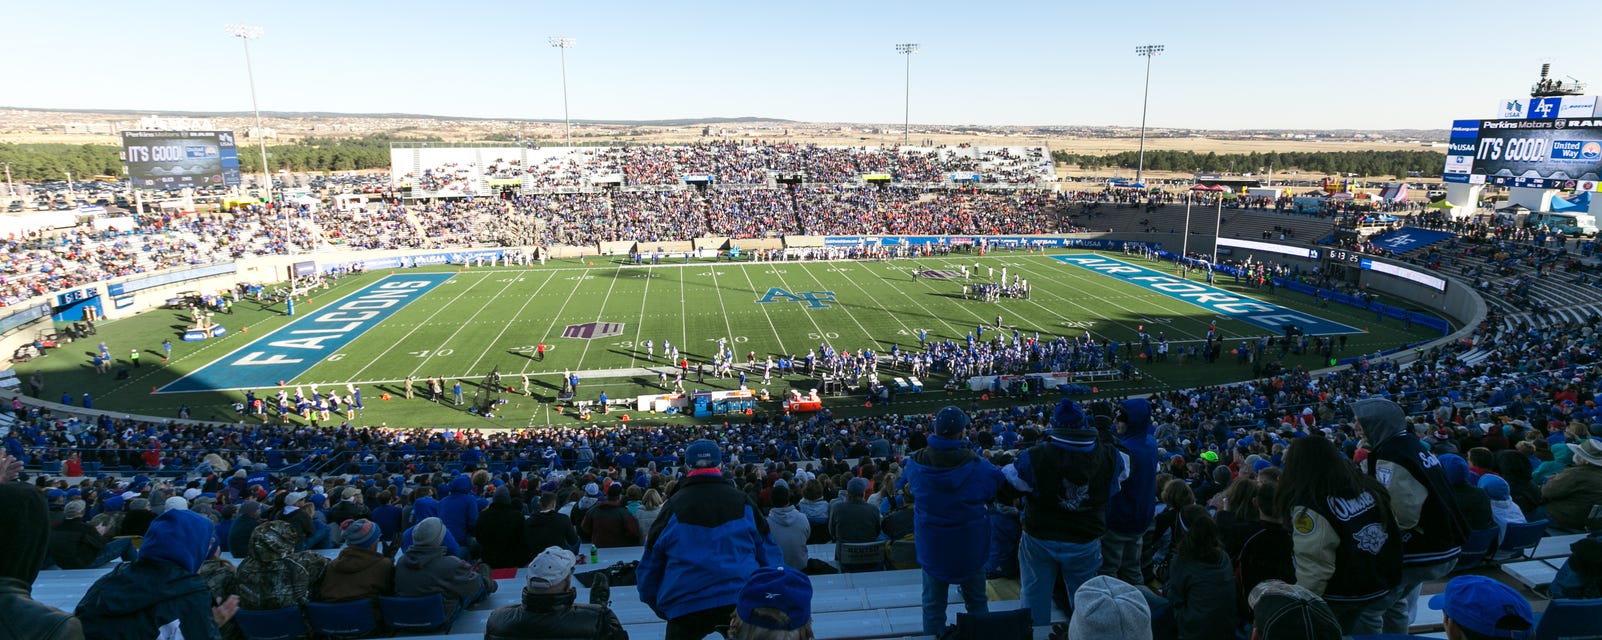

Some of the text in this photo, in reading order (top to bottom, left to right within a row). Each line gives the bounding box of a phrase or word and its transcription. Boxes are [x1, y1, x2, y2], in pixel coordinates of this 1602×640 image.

[1534, 99, 1553, 117] AF
[1483, 121, 1518, 129] Perkins
[1476, 137, 1549, 162] IT'S GOOD!
[1553, 141, 1581, 150] United
[128, 146, 183, 162] IT'S GOOD!
[1562, 150, 1579, 159] Way
[754, 287, 836, 309] AF
[1065, 257, 1319, 326] AIR FORCE
[231, 279, 432, 367] FALCONS
[807, 331, 840, 340] 50
[414, 348, 454, 358] 10
